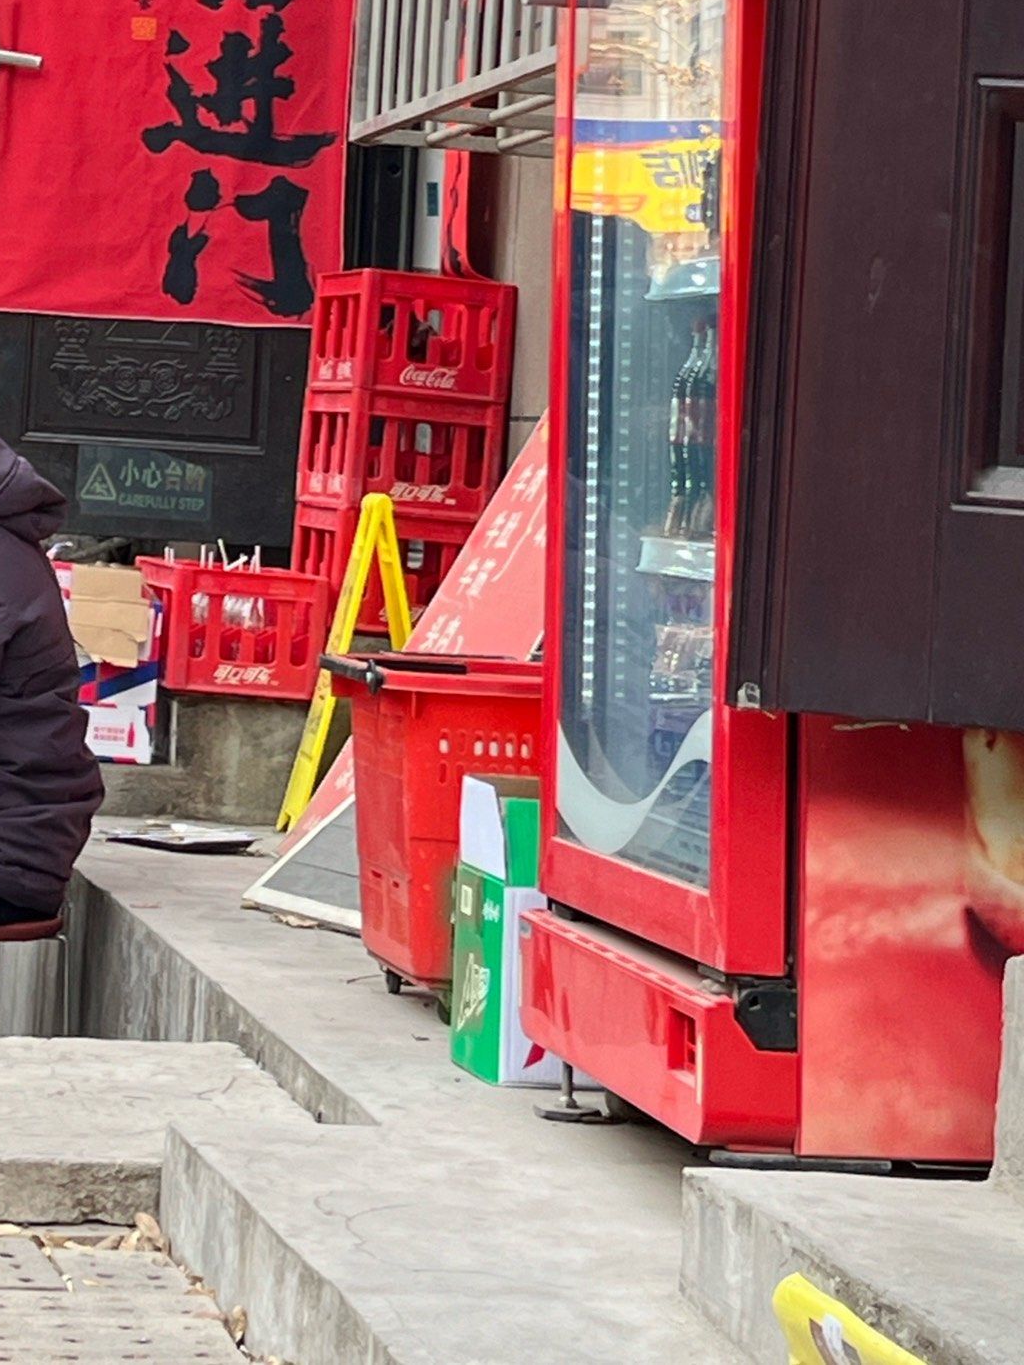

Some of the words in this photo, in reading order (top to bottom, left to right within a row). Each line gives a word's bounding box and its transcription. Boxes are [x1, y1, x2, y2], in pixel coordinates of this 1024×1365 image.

[119, 458, 207, 493] 小心台阶
[118, 493, 177, 510] CAREFULLY
[178, 496, 205, 512] STEP
[213, 664, 276, 686] 可口可乐
